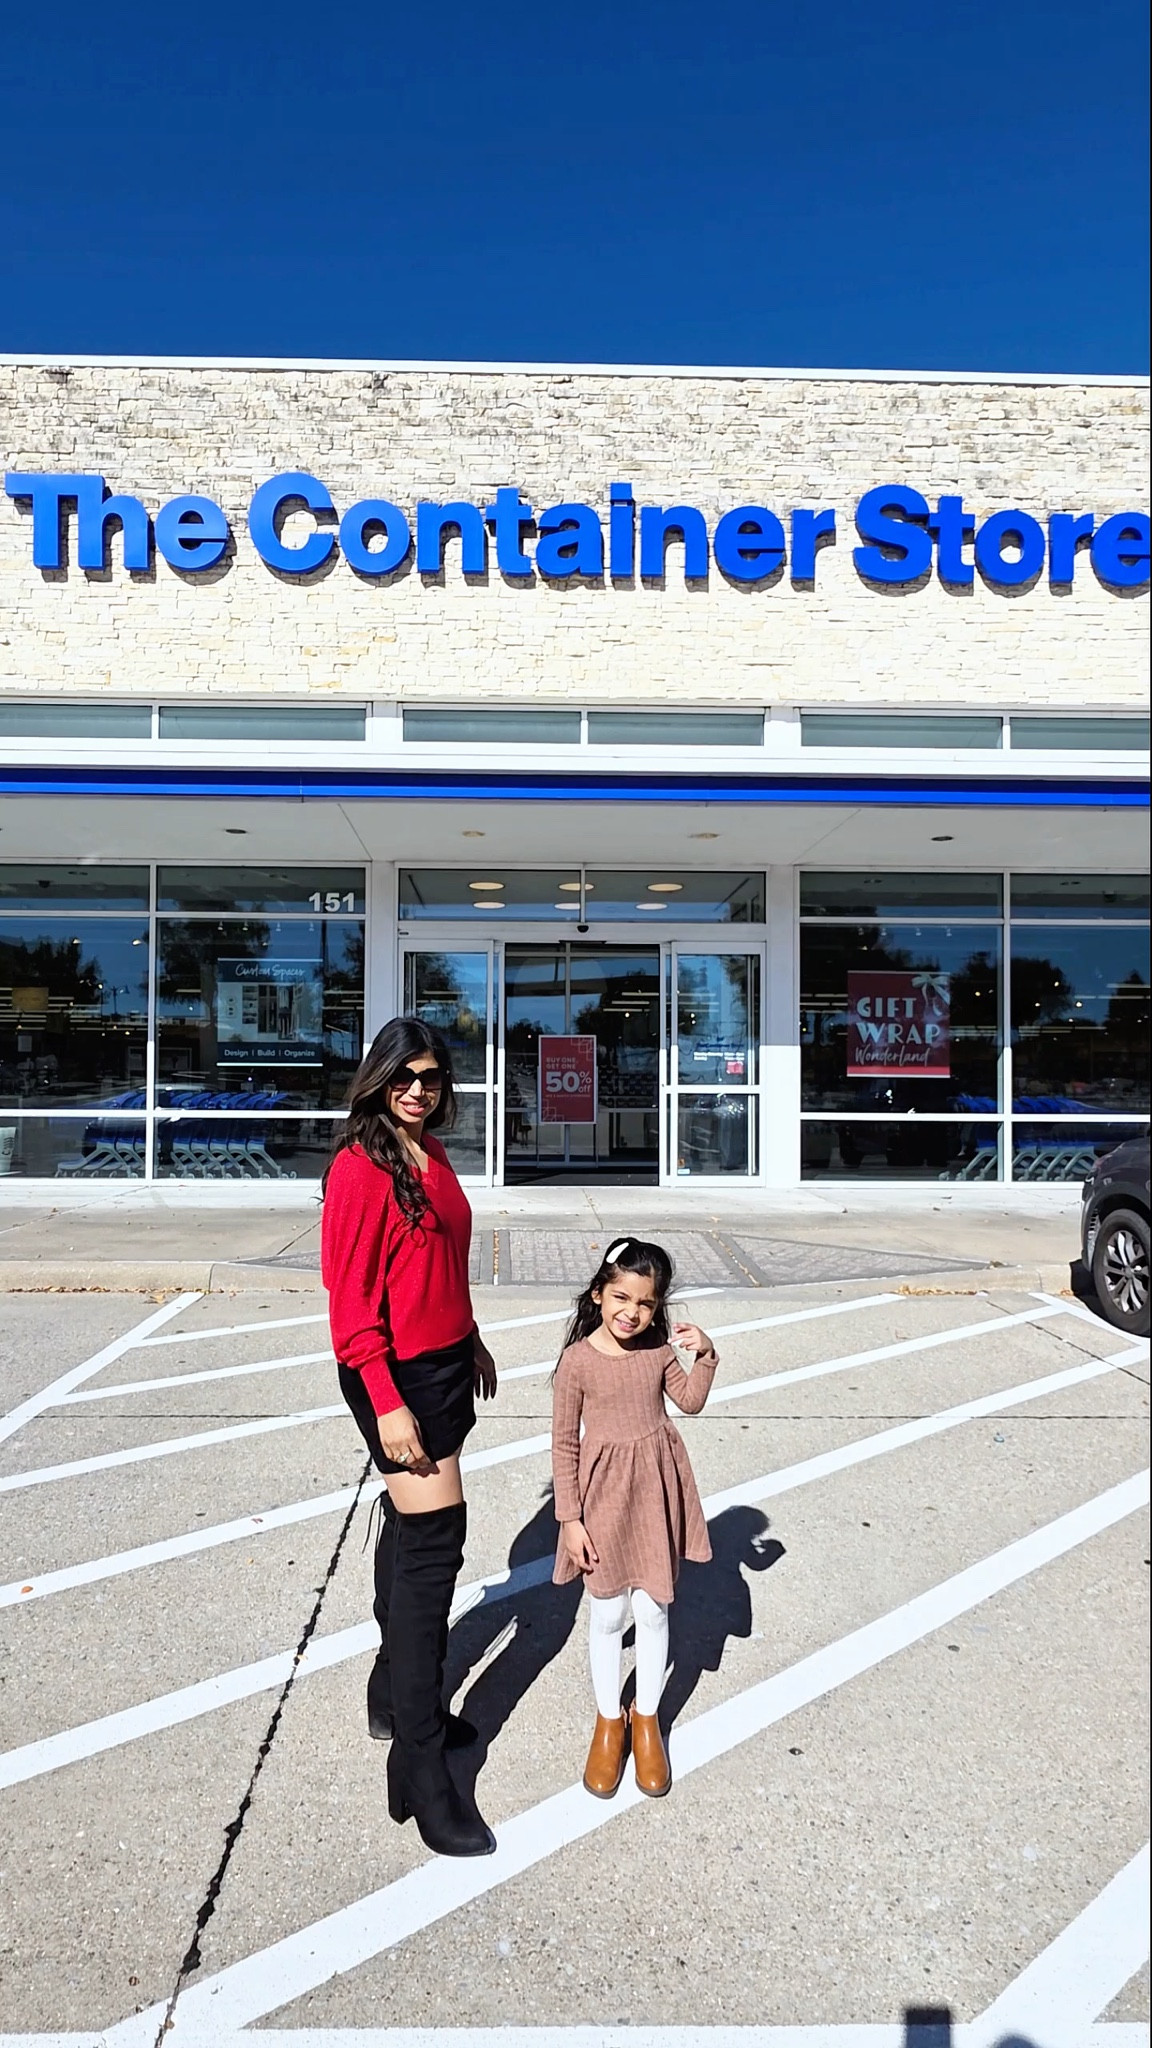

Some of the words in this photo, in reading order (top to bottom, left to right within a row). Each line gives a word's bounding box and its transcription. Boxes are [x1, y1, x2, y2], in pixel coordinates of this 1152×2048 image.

[5, 472, 230, 572] The
[247, 471, 836, 581] Container
[852, 483, 1151, 587] Store
[308, 892, 355, 912] 151
[235, 963, 270, 977] Custom
[271, 964, 305, 980] Spaces
[857, 997, 916, 1018] GIFT
[856, 1022, 941, 1044] WRAP
[224, 1049, 248, 1058] Design
[284, 1049, 315, 1058] Organize
[855, 1044, 931, 1067] Wonderland
[578, 1084, 591, 1093] off
